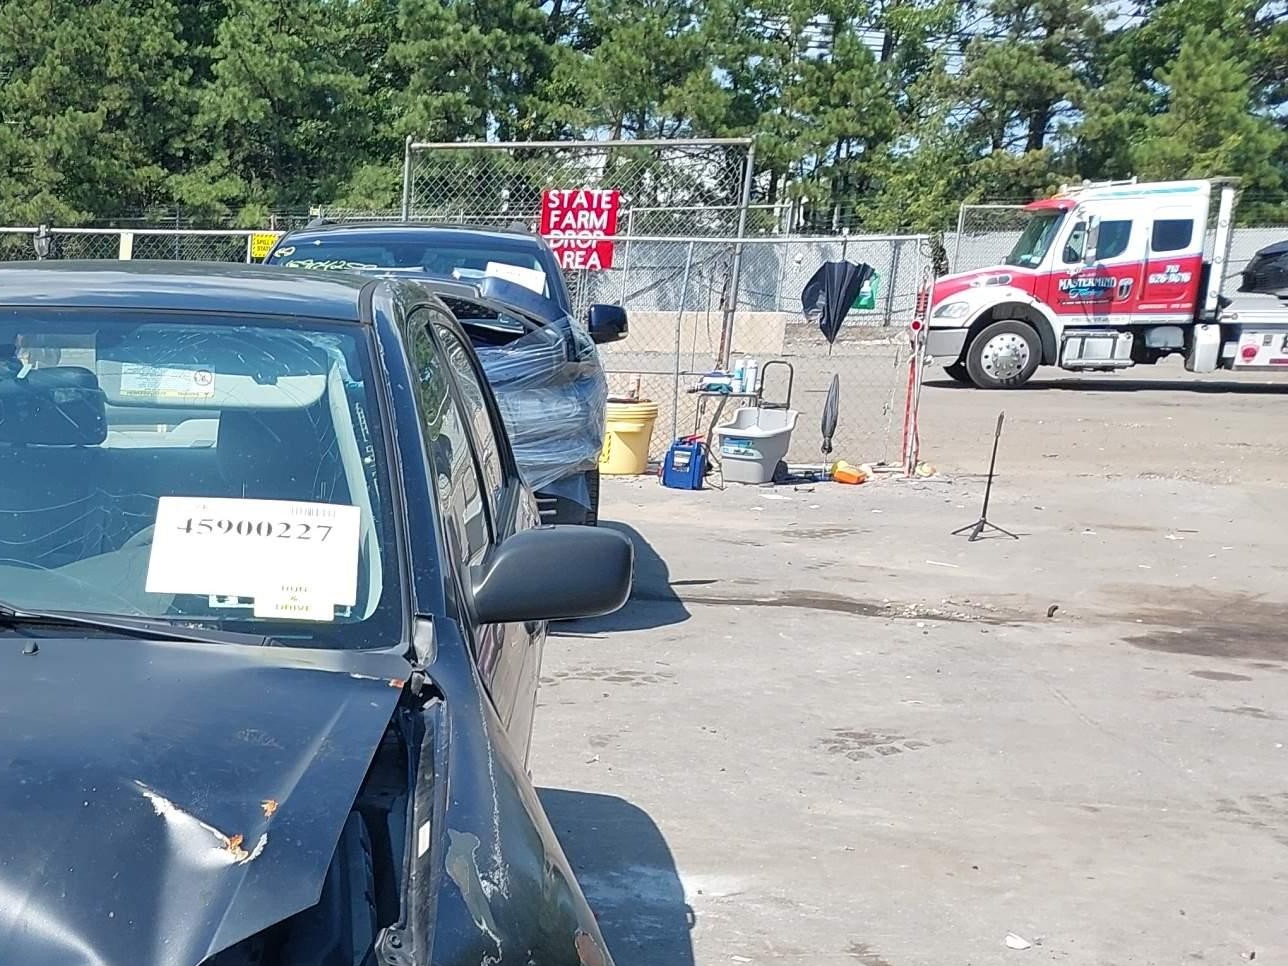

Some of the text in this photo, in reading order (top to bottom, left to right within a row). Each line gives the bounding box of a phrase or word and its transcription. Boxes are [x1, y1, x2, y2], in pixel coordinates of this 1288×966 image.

[548, 189, 613, 209] STATE
[549, 210, 609, 229] FARM
[549, 229, 605, 249] DROP
[177, 518, 334, 542] 45900227
